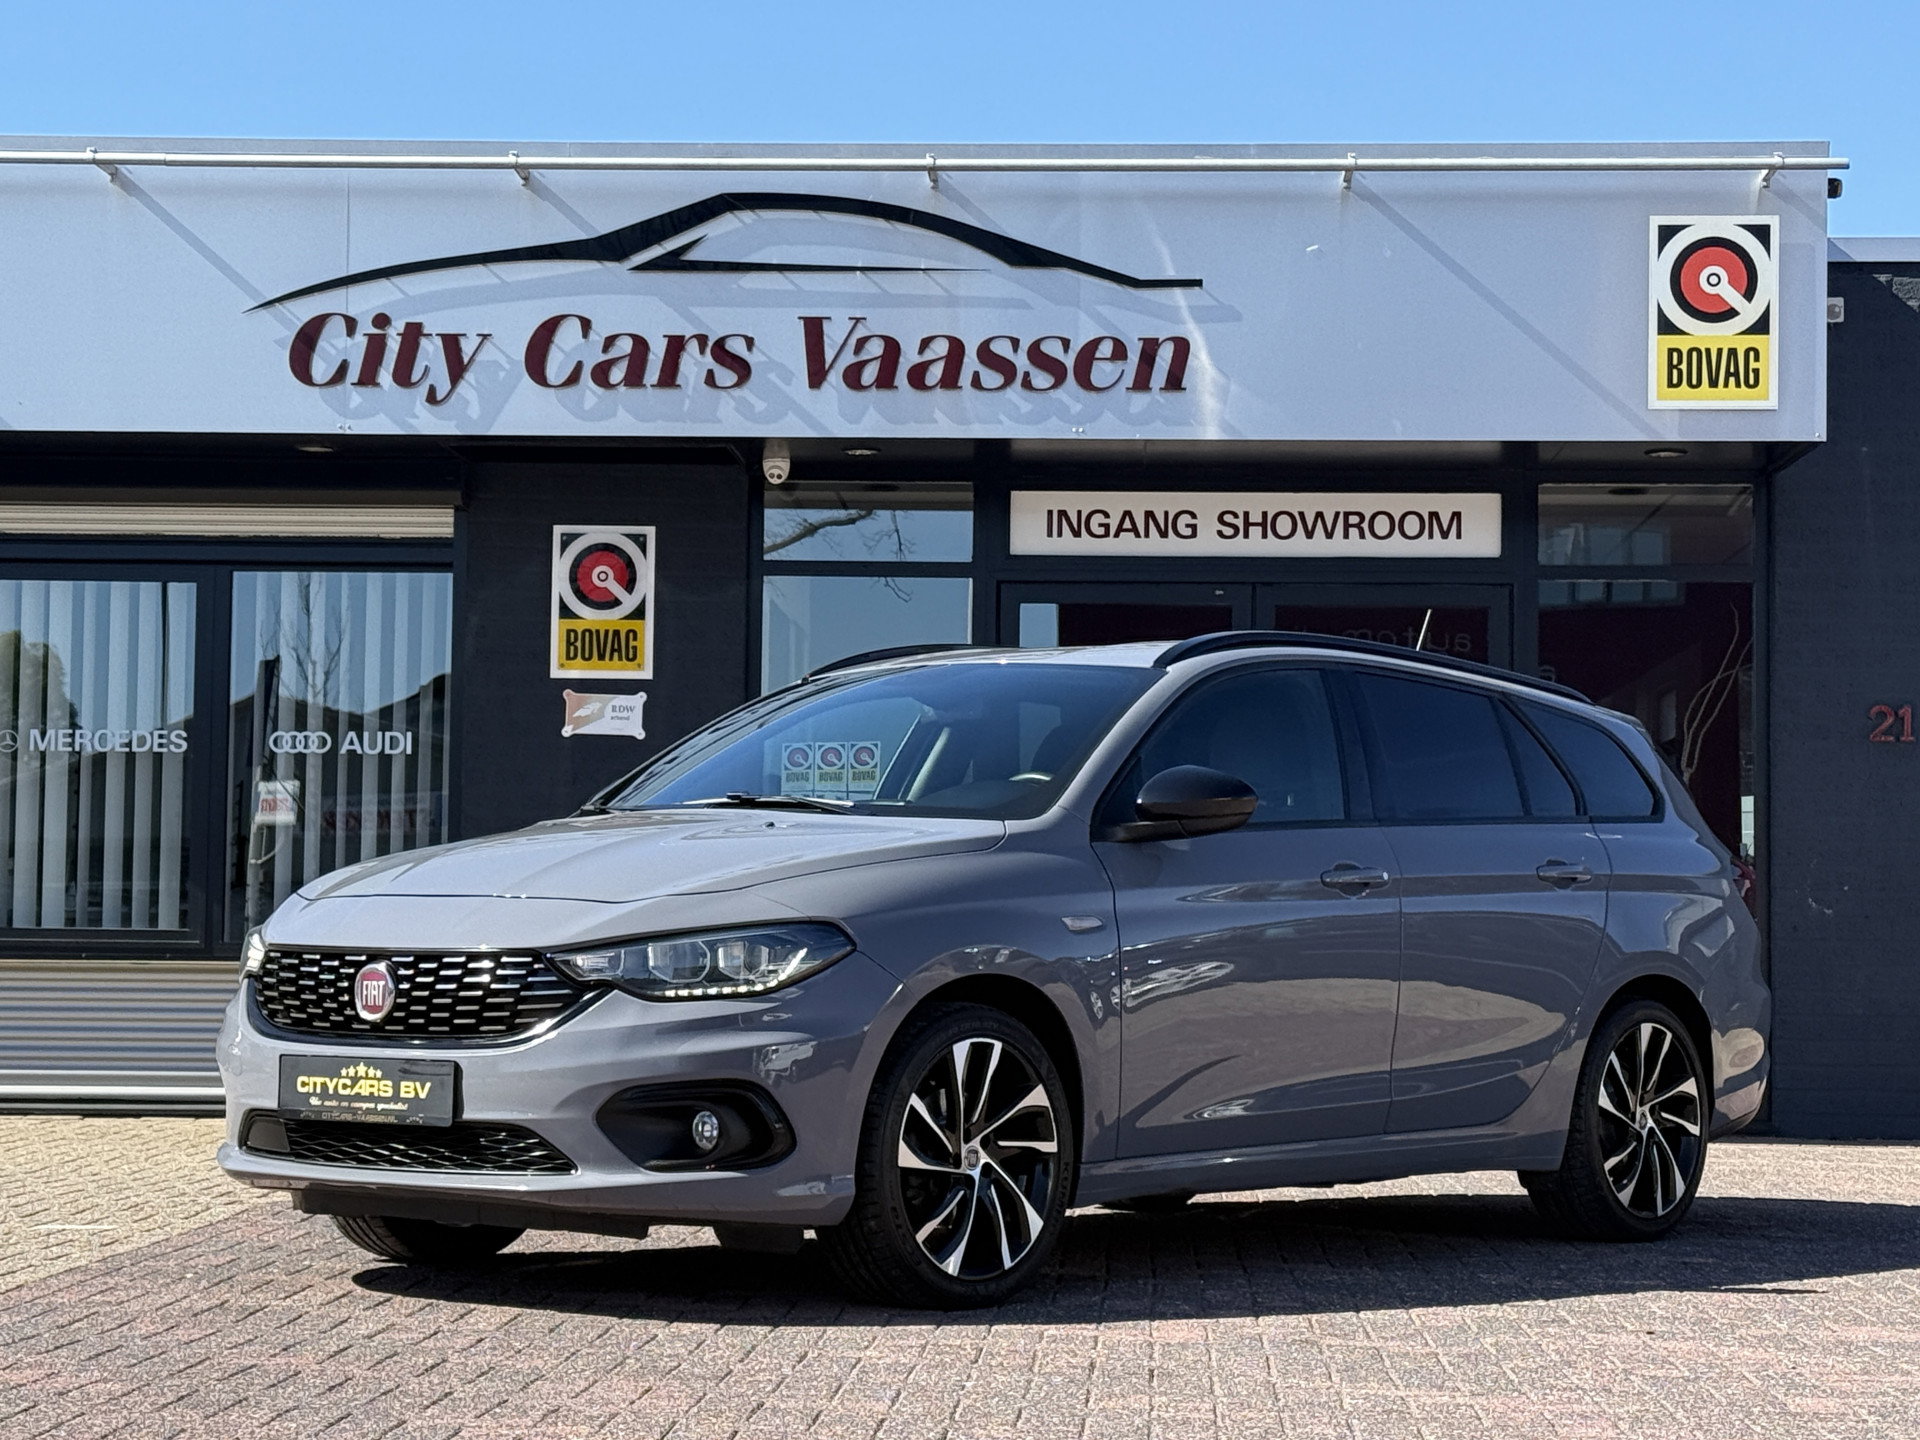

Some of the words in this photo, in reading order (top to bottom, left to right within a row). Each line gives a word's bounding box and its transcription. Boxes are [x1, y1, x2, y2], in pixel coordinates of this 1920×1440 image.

[289, 312, 491, 405] City
[525, 313, 755, 390] Cars
[798, 316, 1191, 392] Vaassen
[1667, 347, 1760, 389] BOVAG
[1046, 508, 1198, 540] INGANG
[1216, 510, 1463, 541] SHOWROOM
[565, 628, 638, 662] BOVAG
[611, 704, 635, 714] RDW
[1869, 704, 1916, 743] 21
[29, 728, 188, 753] MERCEDES
[340, 731, 412, 755] AUDI
[785, 771, 810, 783] BOVAG
[818, 771, 843, 782] BOVAG
[851, 770, 876, 781] BOVAG
[362, 980, 386, 1006] FIAT
[296, 1075, 394, 1098] CITYCARS
[399, 1081, 432, 1099] BV
